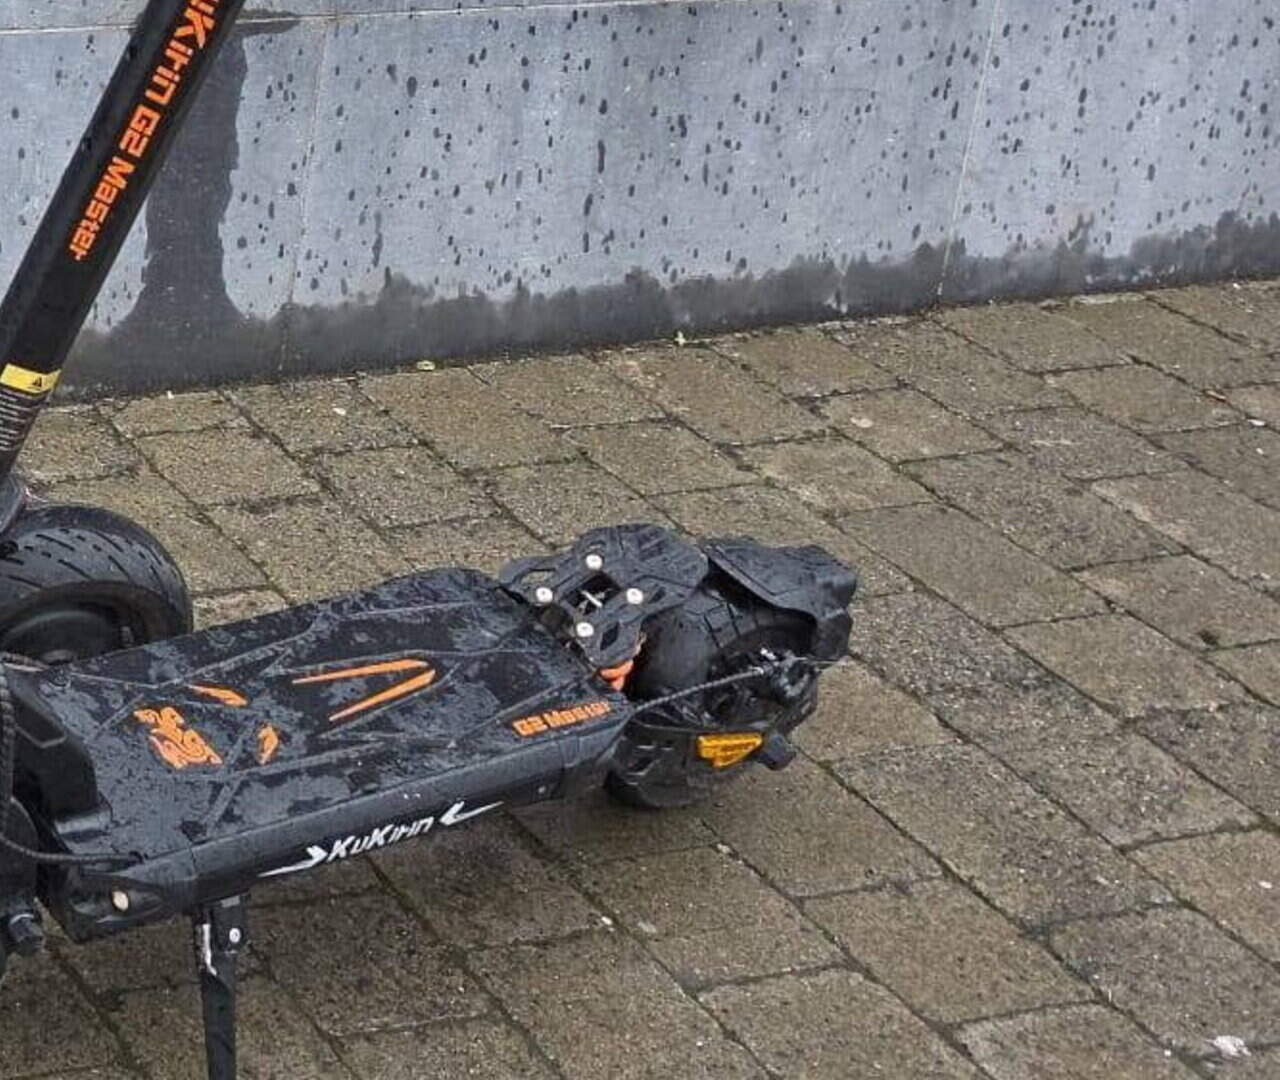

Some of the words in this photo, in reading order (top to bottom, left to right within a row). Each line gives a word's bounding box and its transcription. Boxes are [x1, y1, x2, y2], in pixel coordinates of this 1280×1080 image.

[120, 105, 161, 158] G2
[69, 157, 135, 262] Master
[512, 715, 548, 736] G2
[543, 701, 610, 728] Master
[327, 817, 435, 862] KuKirin
